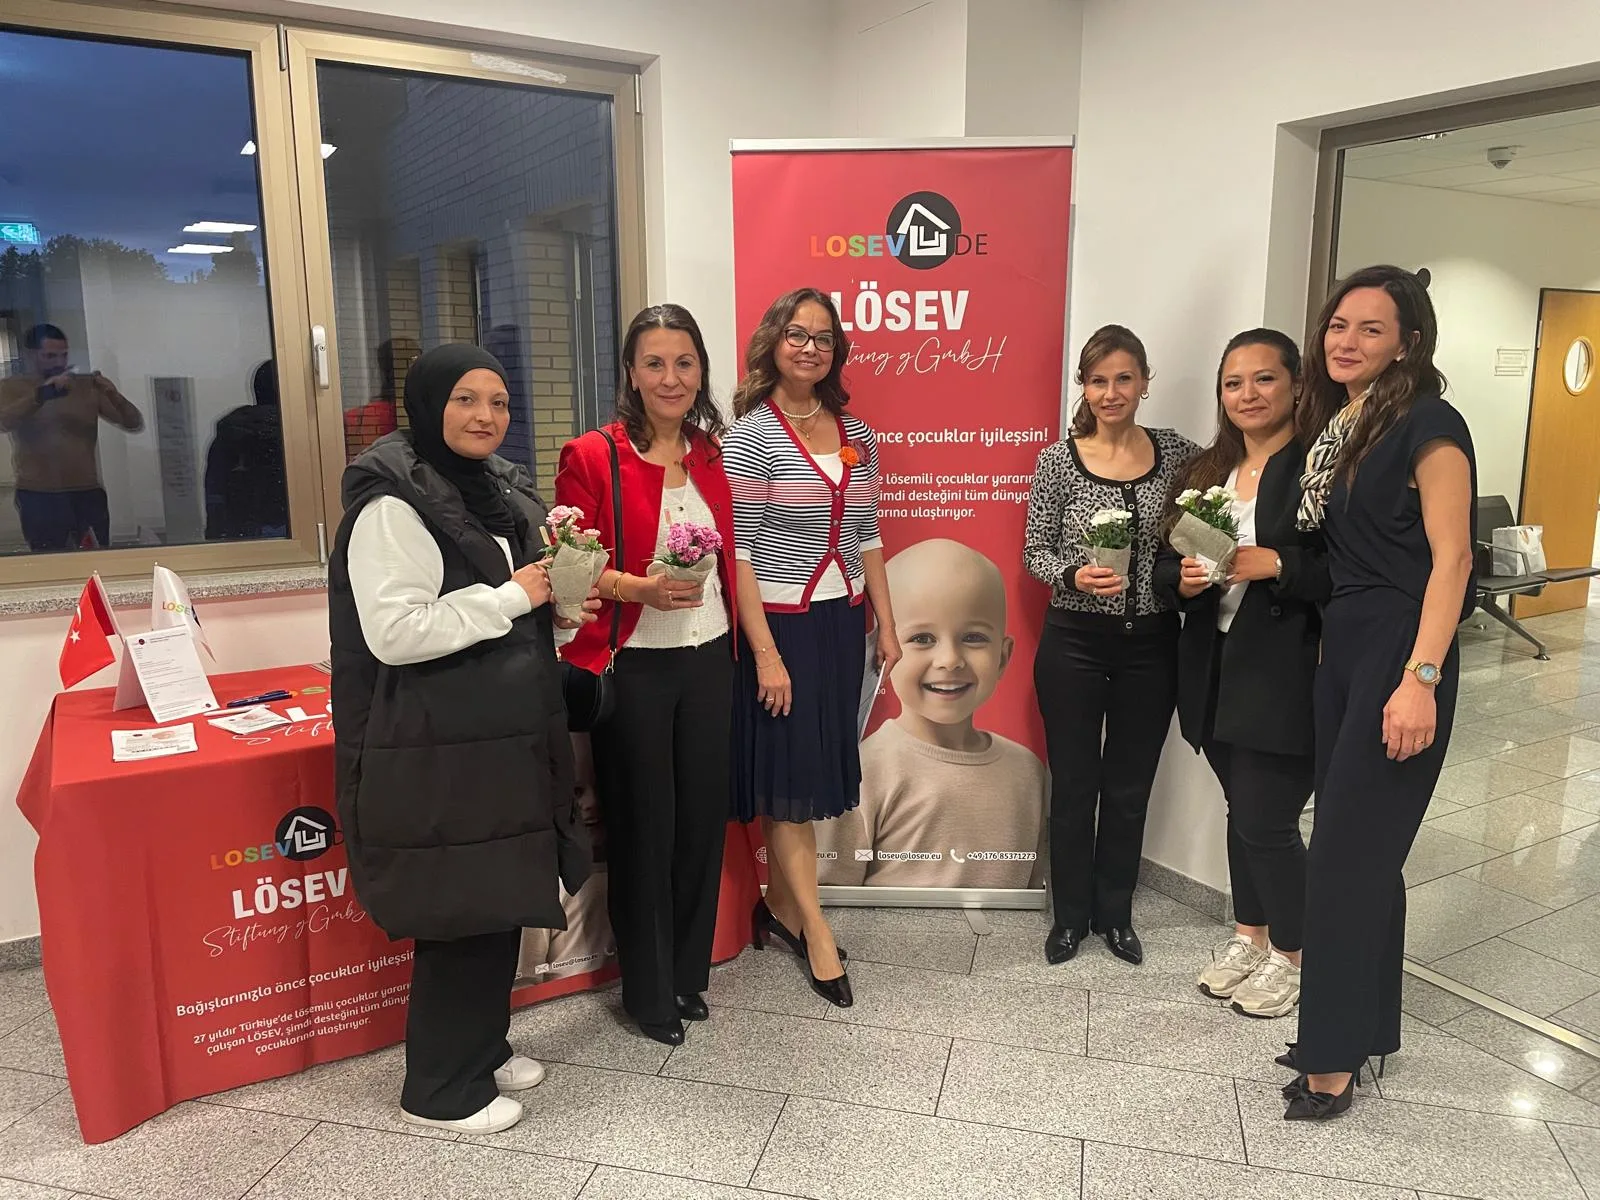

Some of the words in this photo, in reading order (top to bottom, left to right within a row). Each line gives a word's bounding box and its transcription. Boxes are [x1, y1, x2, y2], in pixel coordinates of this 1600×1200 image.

[810, 234, 906, 257] LOSEV
[954, 233, 988, 255] DE
[907, 428, 976, 447] çocuklar
[980, 427, 1048, 447] iyileşsin!
[886, 473, 933, 485] lösemili
[936, 473, 989, 487] çocuklar
[879, 490, 905, 501] imdi
[908, 489, 961, 504] desteğini
[964, 490, 988, 501] tüm
[991, 489, 1030, 504] dünya
[911, 507, 976, 520] ulaştırıyor.
[210, 839, 292, 871] LOSEV
[984, 851, 998, 860] 176
[232, 867, 348, 919] LÖSEV
[202, 921, 290, 957] Stiftung
[176, 986, 272, 1016] Bağışlarınızla
[275, 977, 306, 993] önce
[308, 963, 365, 985] çocuklar
[193, 1033, 206, 1044] 27
[208, 1025, 237, 1043] yıldır
[295, 1000, 334, 1019] lösemili
[336, 990, 379, 1009] çocuklar
[207, 1036, 246, 1056] çalışan
[247, 1027, 284, 1043] LÖSEV,
[286, 1018, 313, 1036] şimdi
[314, 1007, 359, 1024] desteğini
[360, 1001, 381, 1013] tüm
[255, 1029, 315, 1056] çocuklarına
[317, 1017, 372, 1036] ulaştırıyor.
